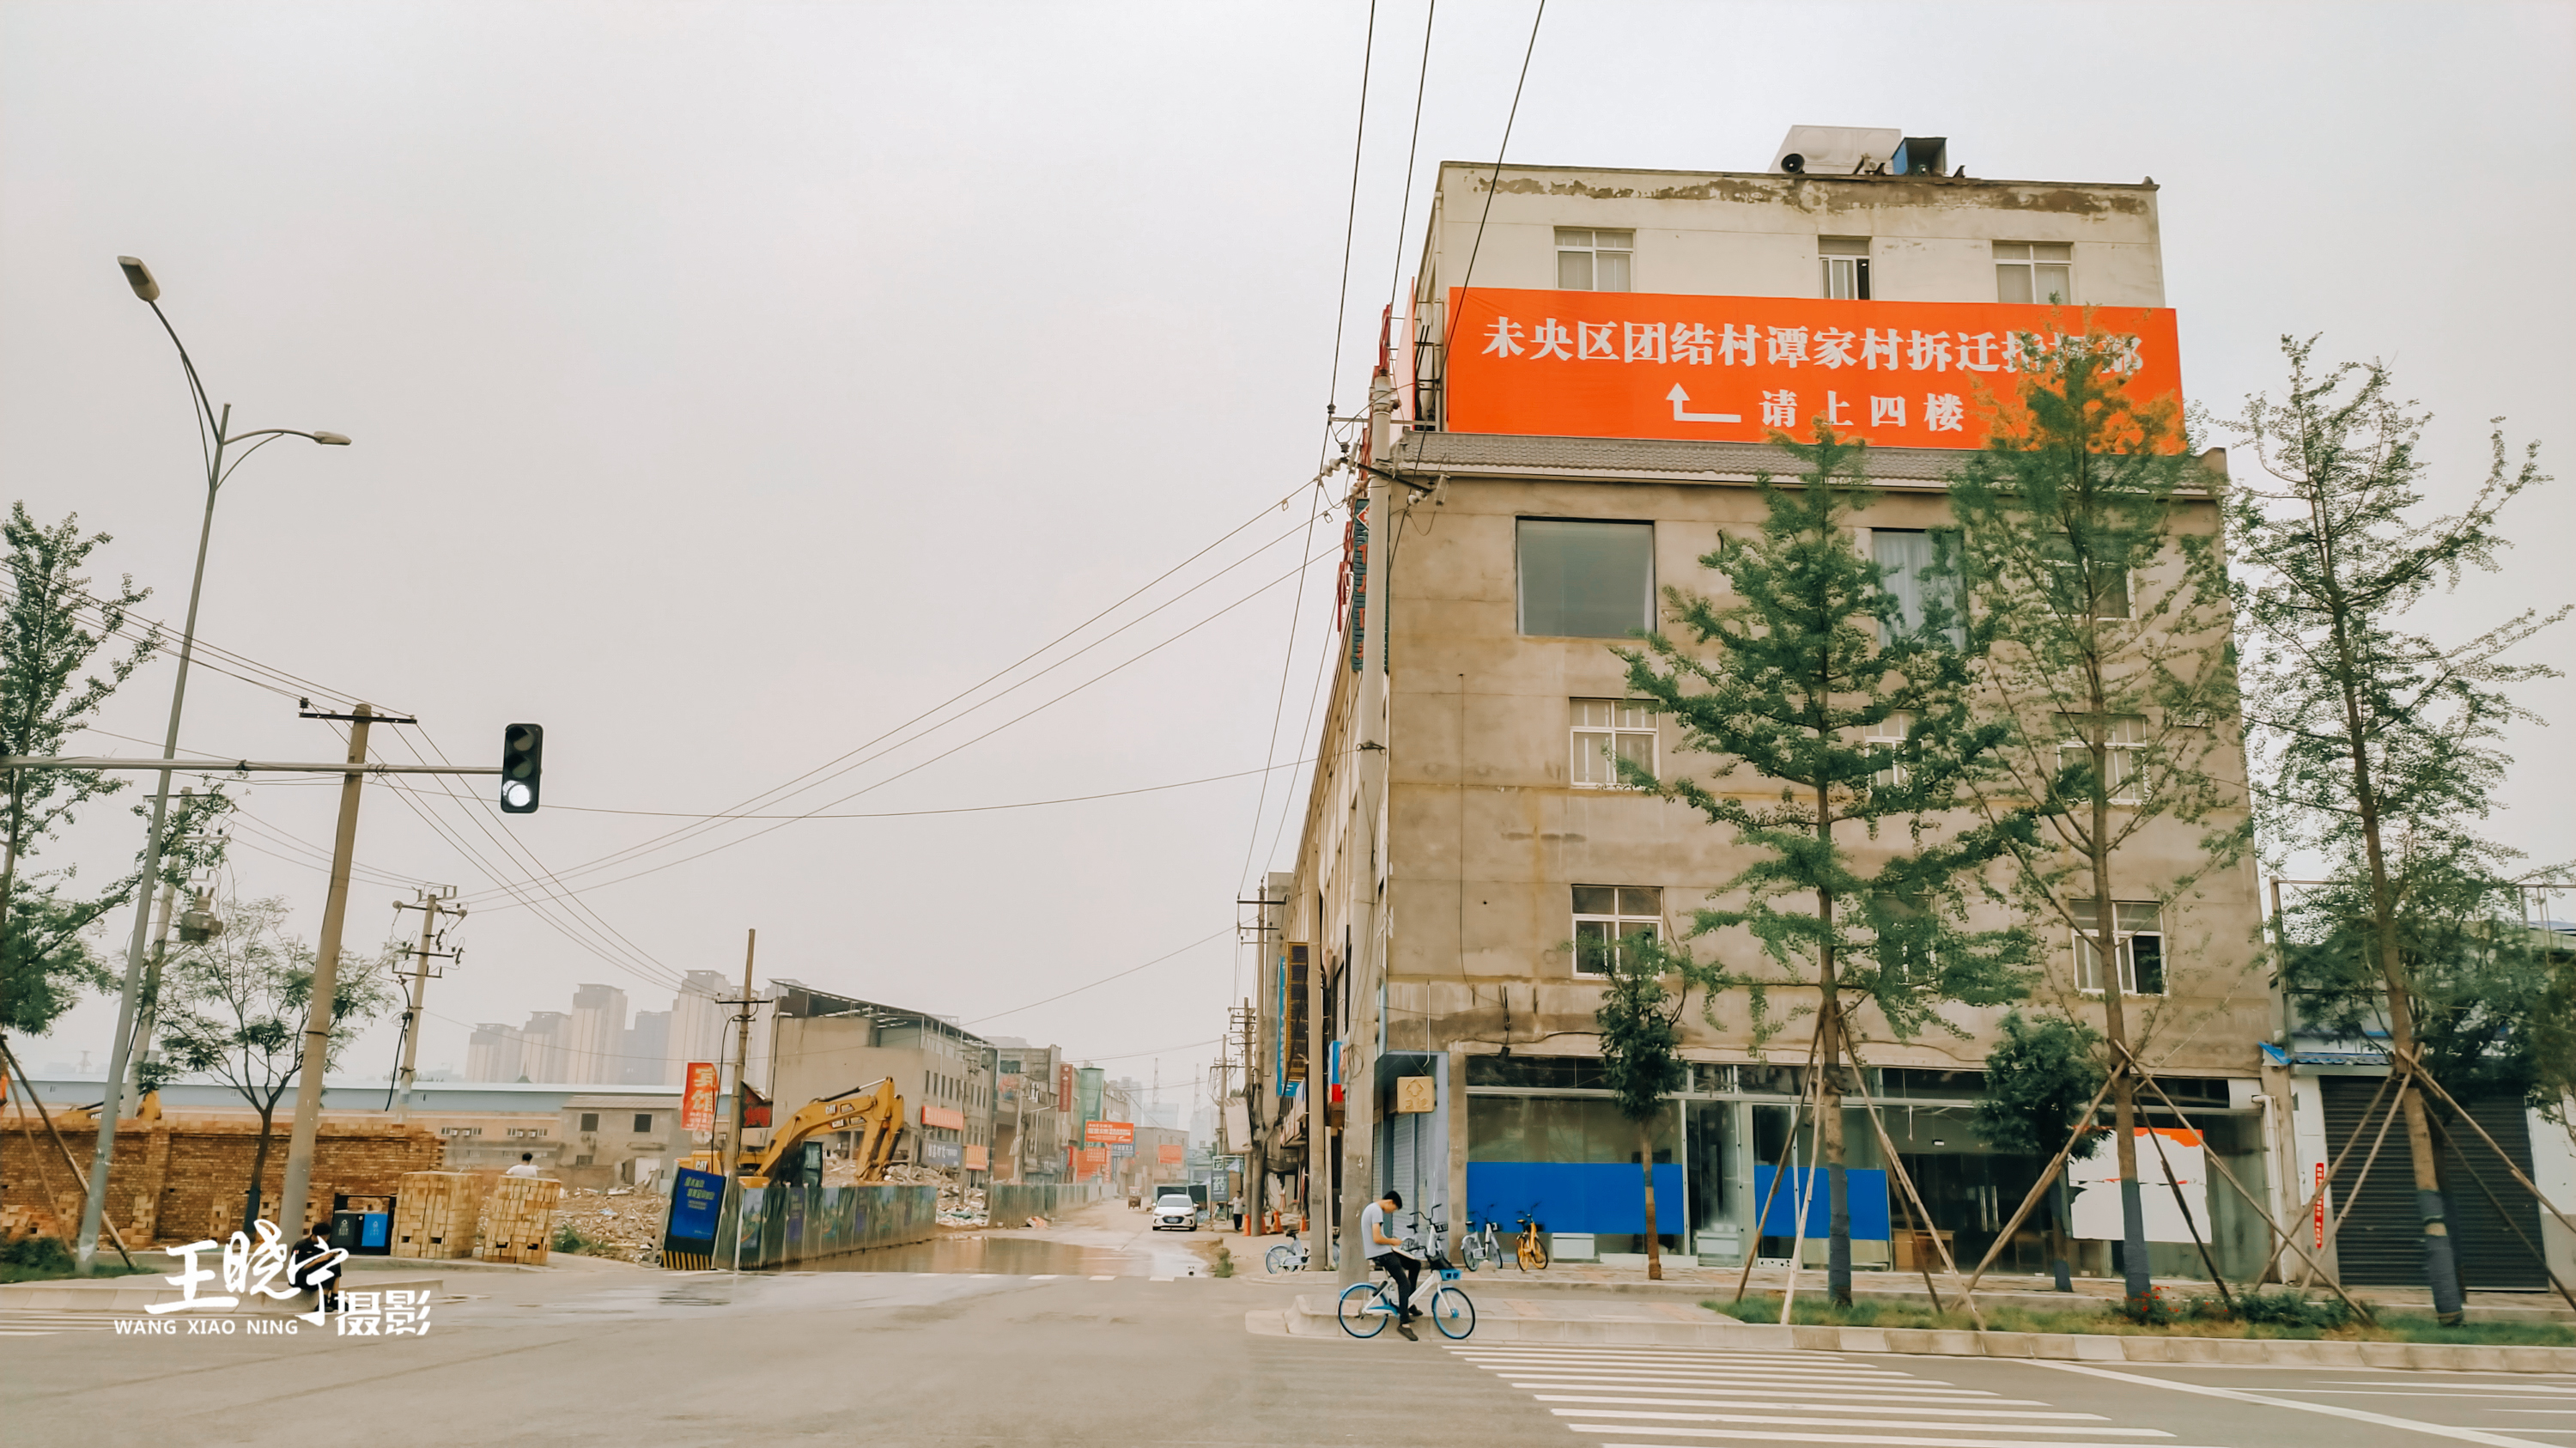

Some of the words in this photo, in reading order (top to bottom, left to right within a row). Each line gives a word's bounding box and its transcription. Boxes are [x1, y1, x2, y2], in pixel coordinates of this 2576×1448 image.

[1759, 389, 1964, 433] 请上四楼
[696, 1160, 708, 1171] CAT
